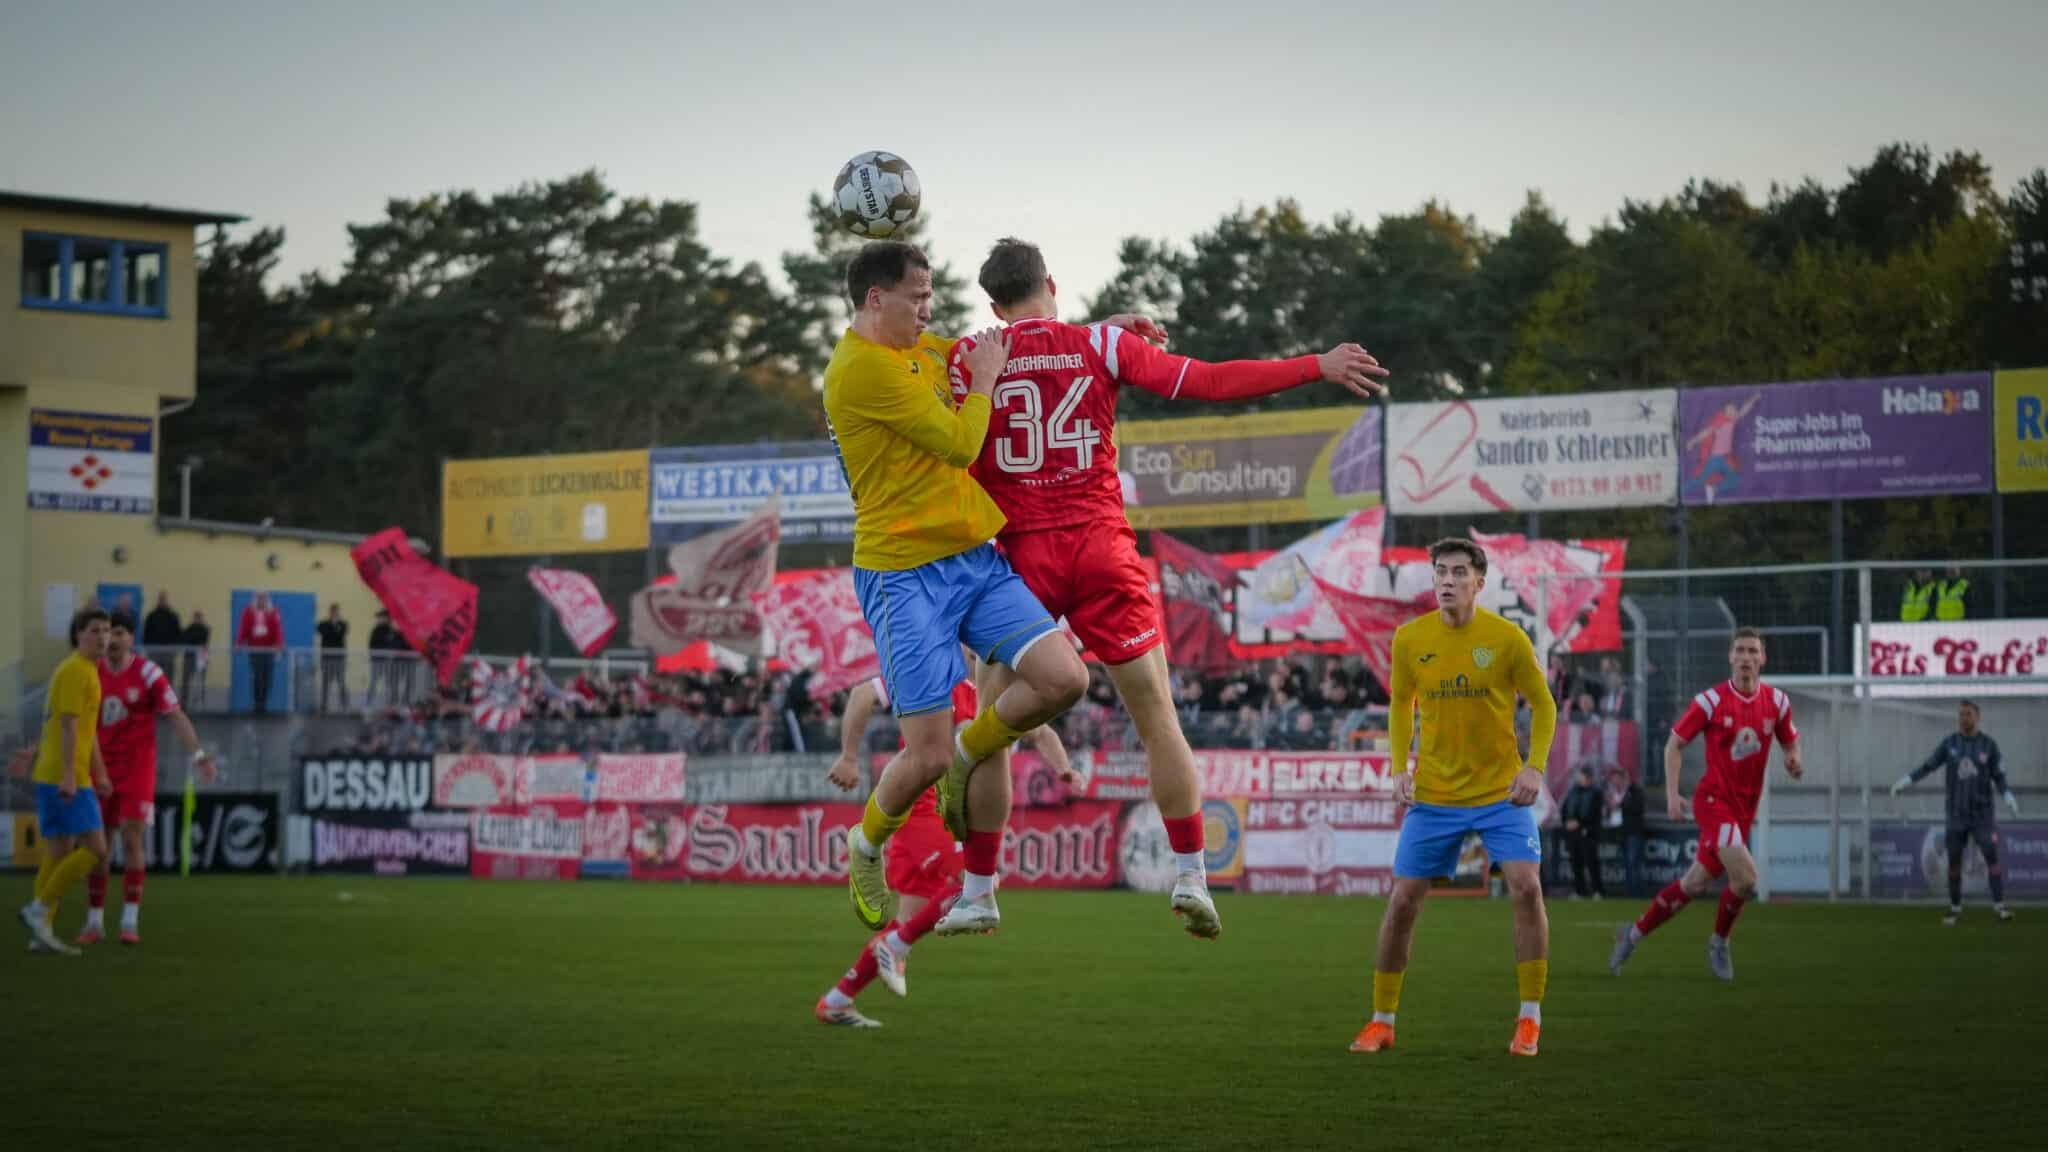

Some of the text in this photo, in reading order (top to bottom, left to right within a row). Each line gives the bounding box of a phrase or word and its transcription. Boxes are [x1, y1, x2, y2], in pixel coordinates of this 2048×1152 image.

[859, 167, 880, 215] DERBYSTAR
[993, 374, 1100, 473] 34
[1476, 431, 1670, 466] Sandro Schleusner
[1166, 462, 1293, 497] Consulting
[1933, 637, 2034, 675] Café
[303, 759, 430, 811] DESSAU
[1300, 801, 1396, 824] CHEMIE
